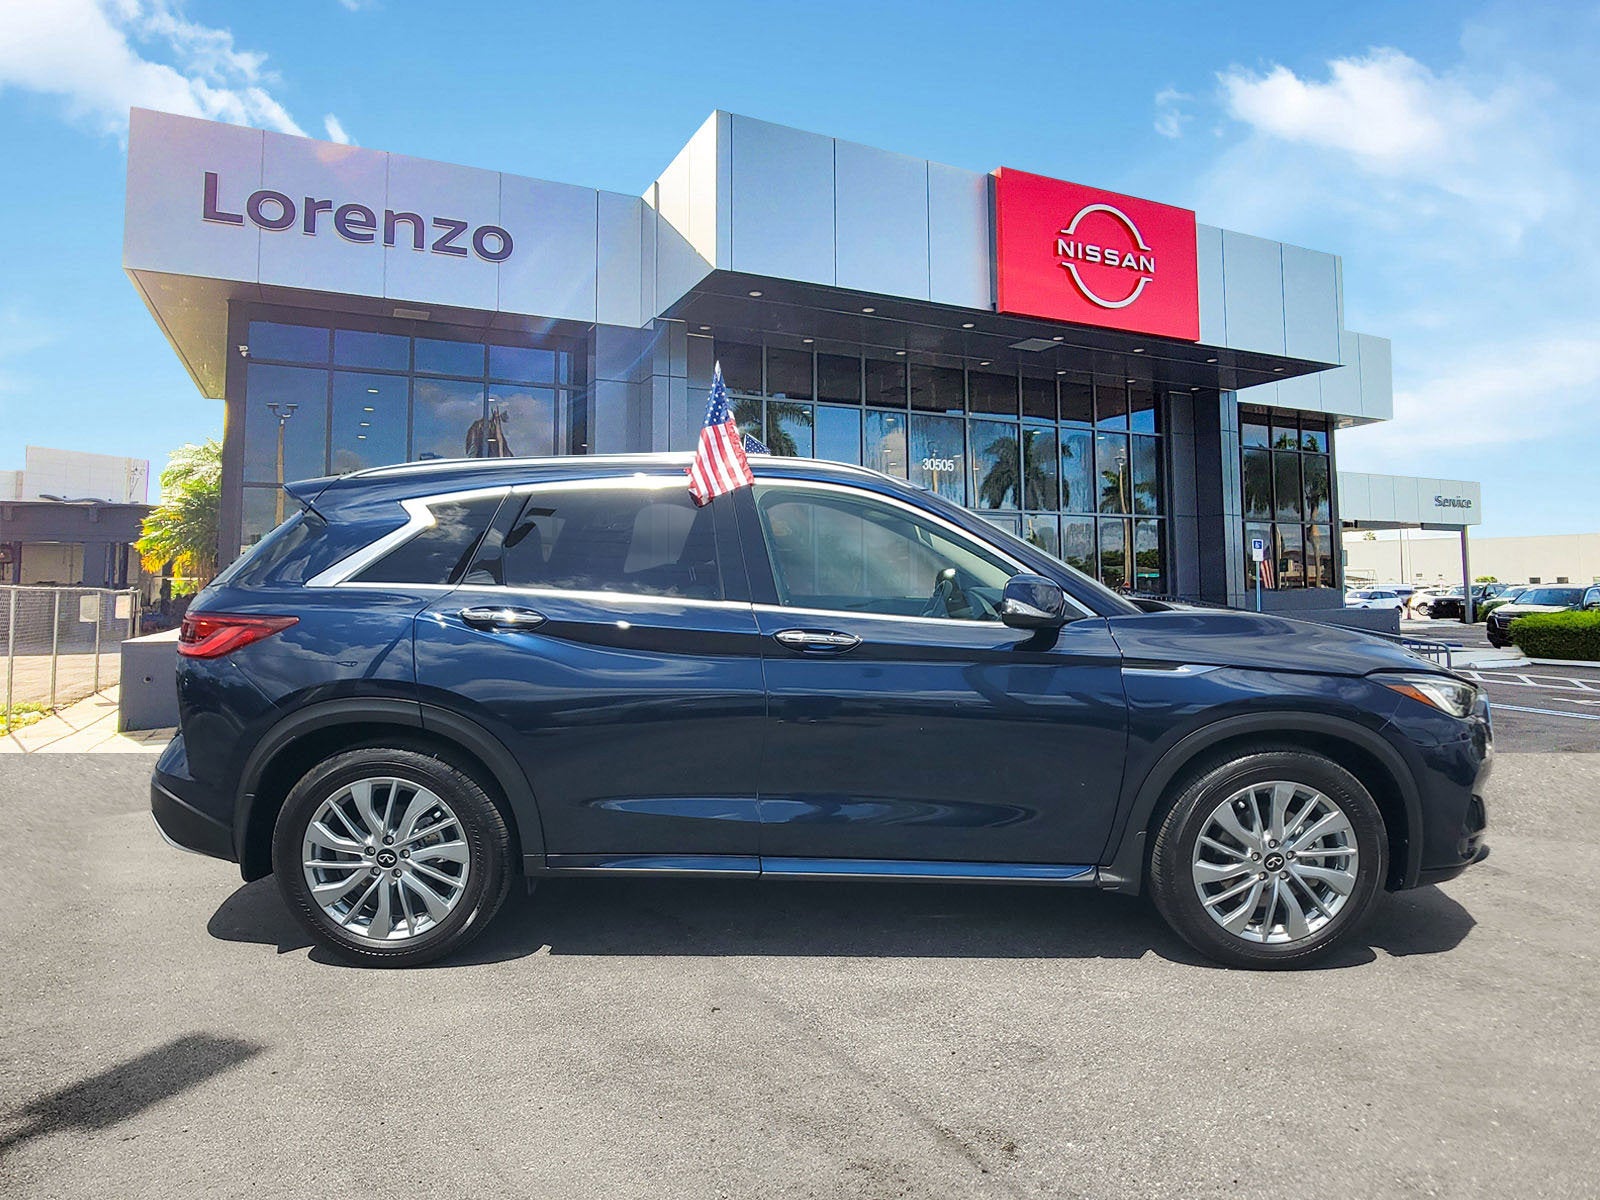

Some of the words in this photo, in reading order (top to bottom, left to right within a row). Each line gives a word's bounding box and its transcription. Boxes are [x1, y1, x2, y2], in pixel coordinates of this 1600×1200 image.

[202, 170, 514, 262] Lorenzo
[1057, 238, 1155, 273] NISSAN
[922, 457, 955, 472] 30505
[1434, 495, 1472, 509] Service
